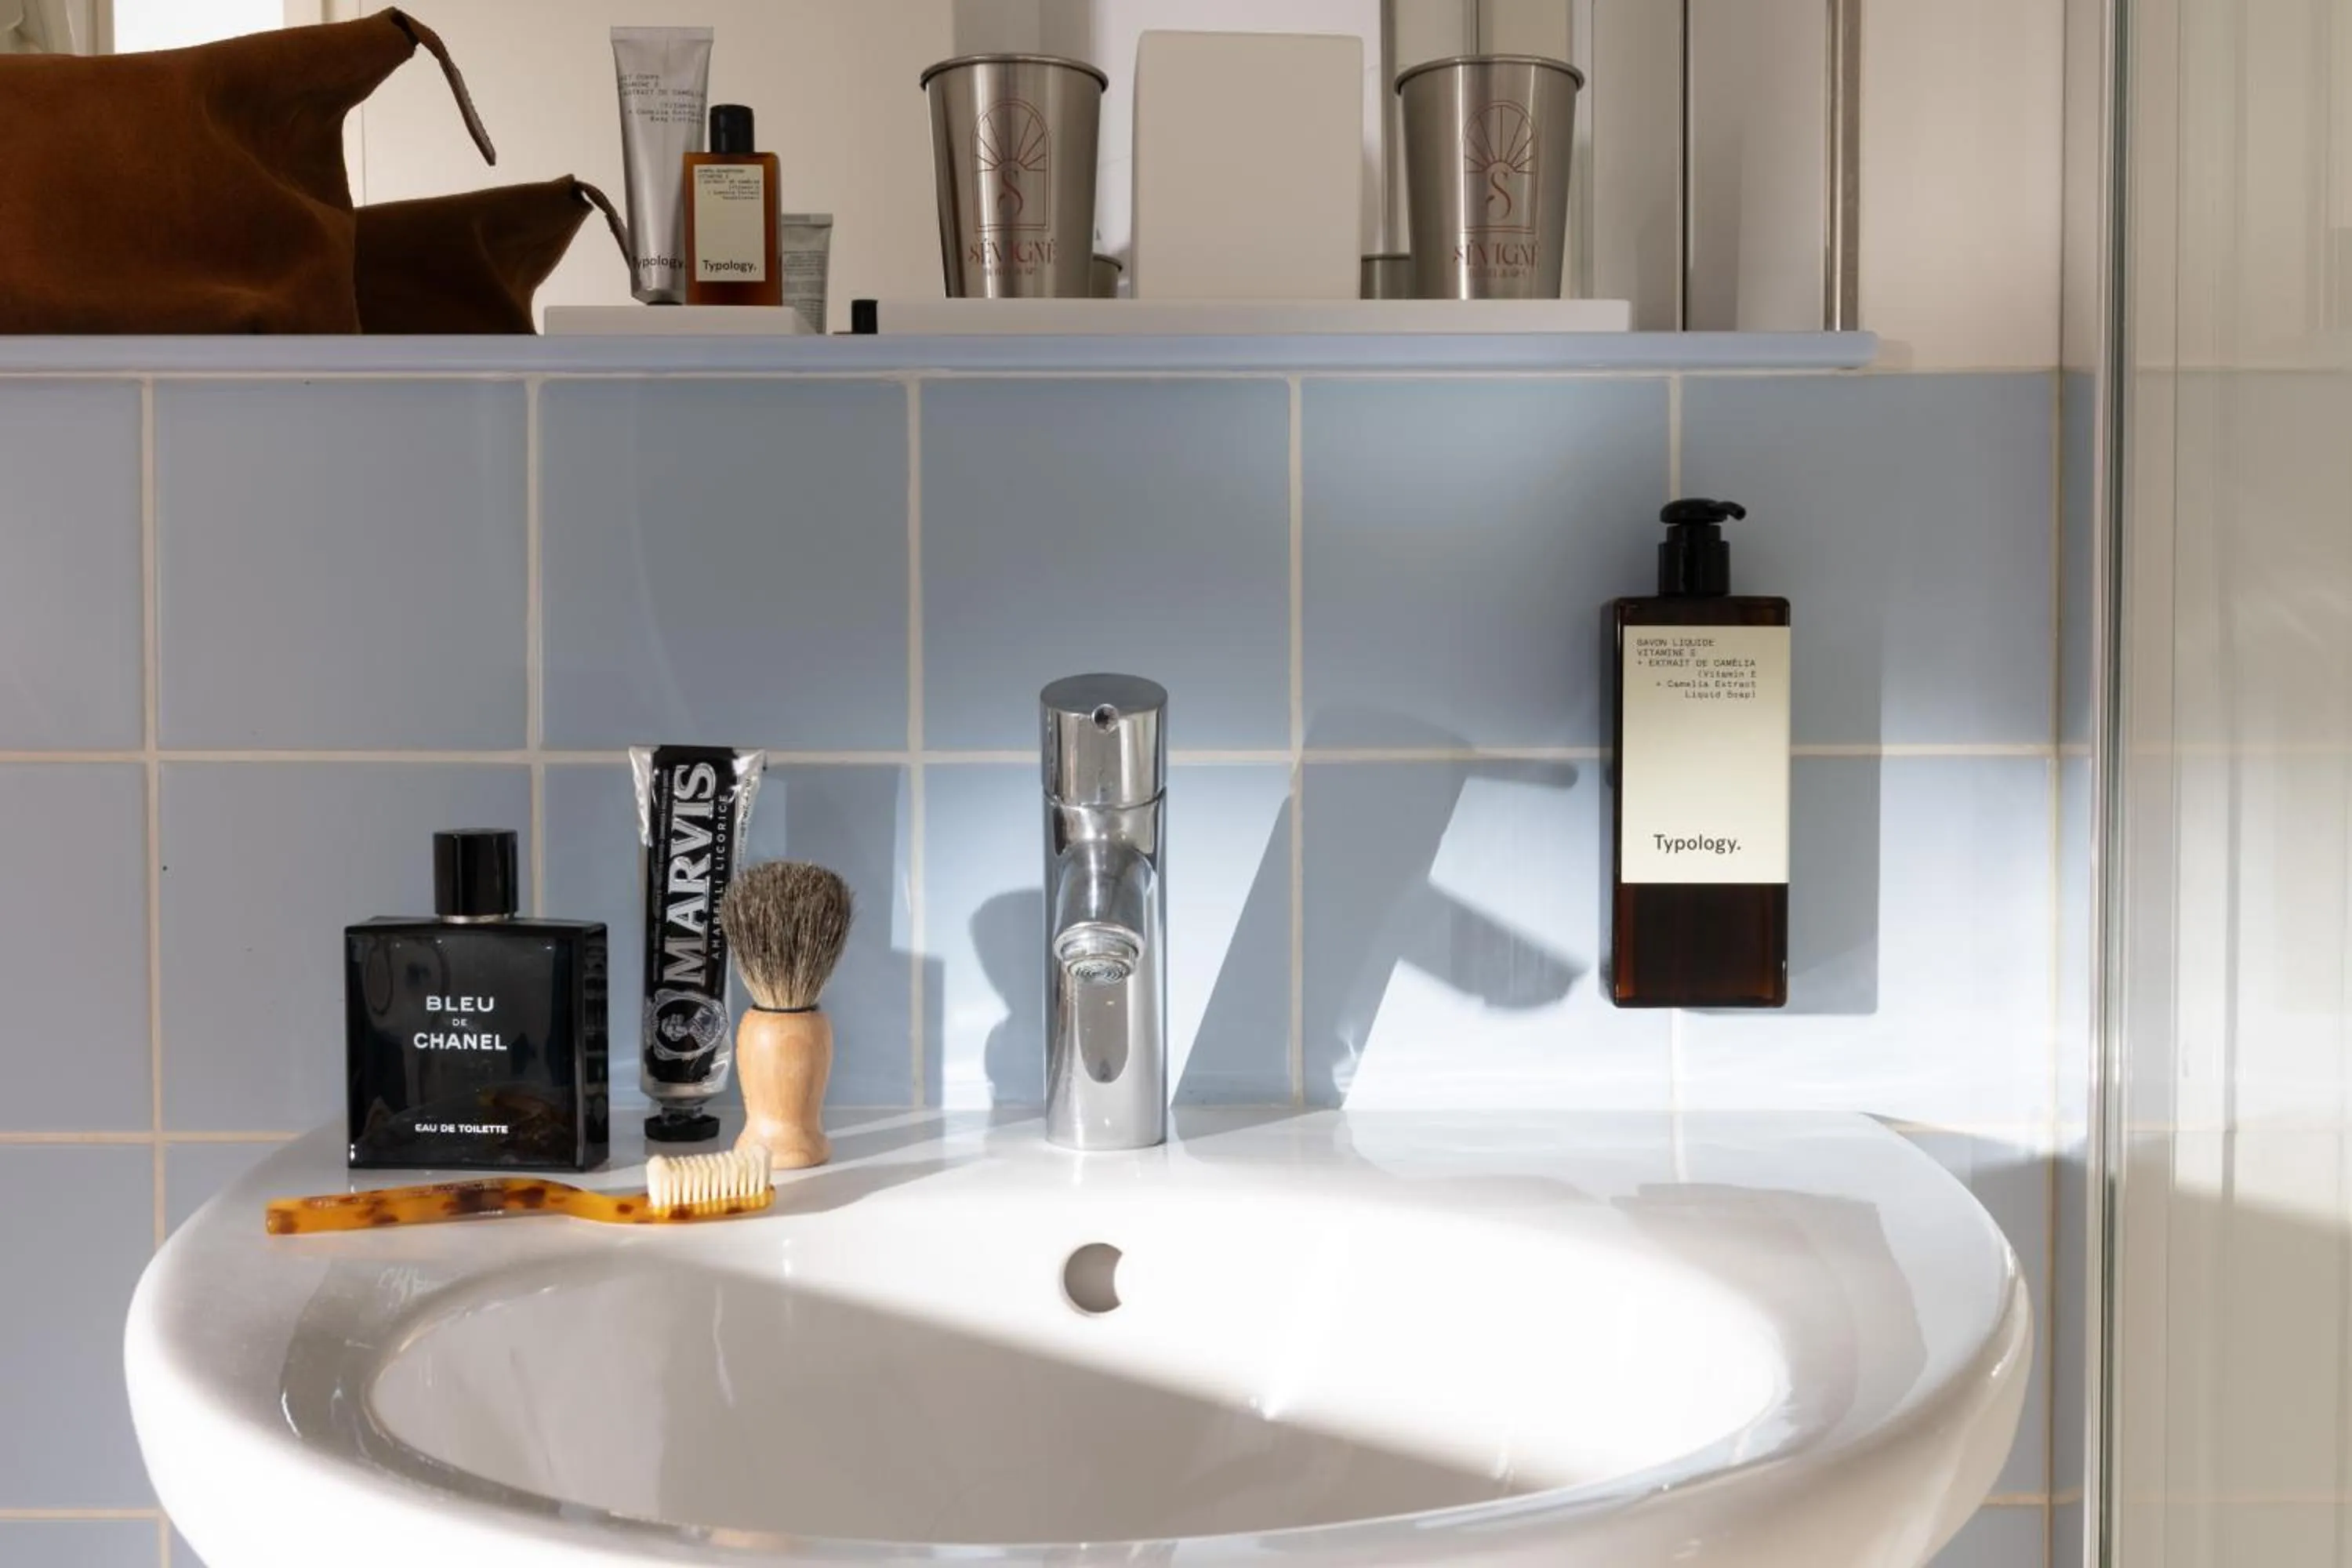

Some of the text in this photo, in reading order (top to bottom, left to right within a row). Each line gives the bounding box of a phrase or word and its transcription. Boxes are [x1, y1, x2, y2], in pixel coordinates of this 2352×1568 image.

[702, 260, 757, 273] Typology.
[1690, 648, 1696, 657] E
[1713, 657, 1756, 667] CAMÉLIA
[1685, 690, 1755, 699] Liquid Soap)
[714, 795, 728, 871] LICORICE
[1653, 833, 1741, 855] Typology.
[662, 761, 717, 986] MARVIS
[426, 995, 495, 1012] BLEU
[413, 1032, 507, 1051] CHANEL
[415, 1123, 509, 1134] EAU DE TOILETTE
